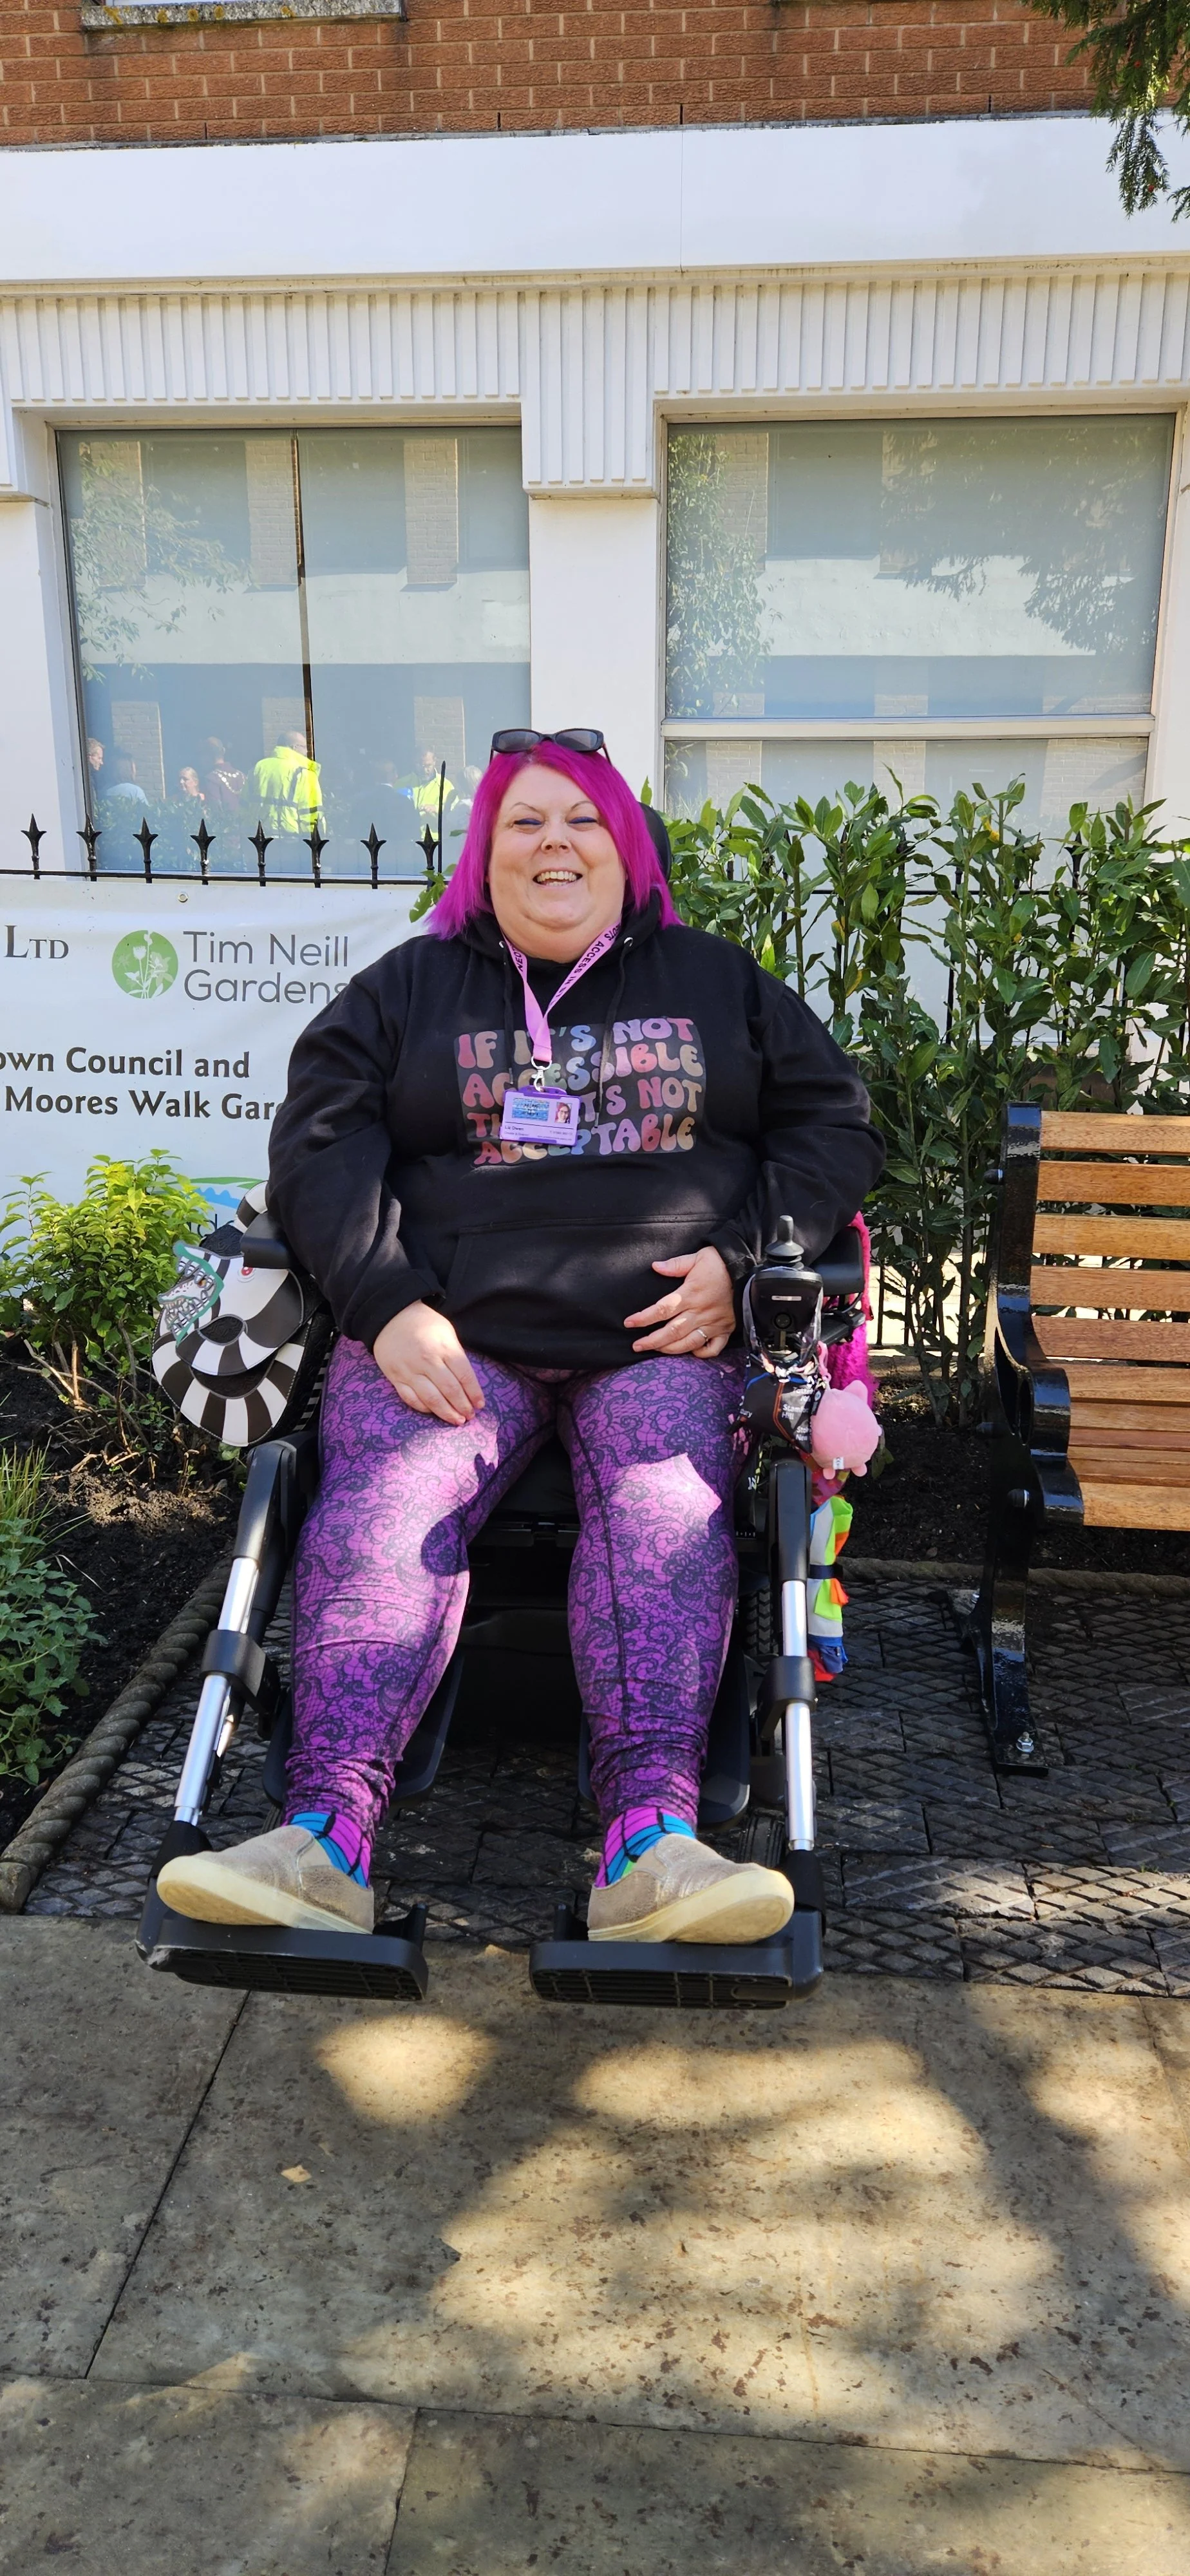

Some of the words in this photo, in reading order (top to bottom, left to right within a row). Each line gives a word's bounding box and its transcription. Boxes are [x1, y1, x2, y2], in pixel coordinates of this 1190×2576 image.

[4, 925, 69, 959] LTD
[183, 931, 252, 964] Tim
[269, 933, 348, 967] Neill
[574, 940, 605, 974] ACCESS
[458, 1030, 497, 1069] IF
[514, 1025, 596, 1065] I'S
[613, 1018, 694, 1044] NOT
[66, 1046, 182, 1076] Council
[194, 1051, 250, 1078] and
[5, 1085, 118, 1115] Moores
[128, 1090, 211, 1119] Walk
[638, 1077, 703, 1112] NOT
